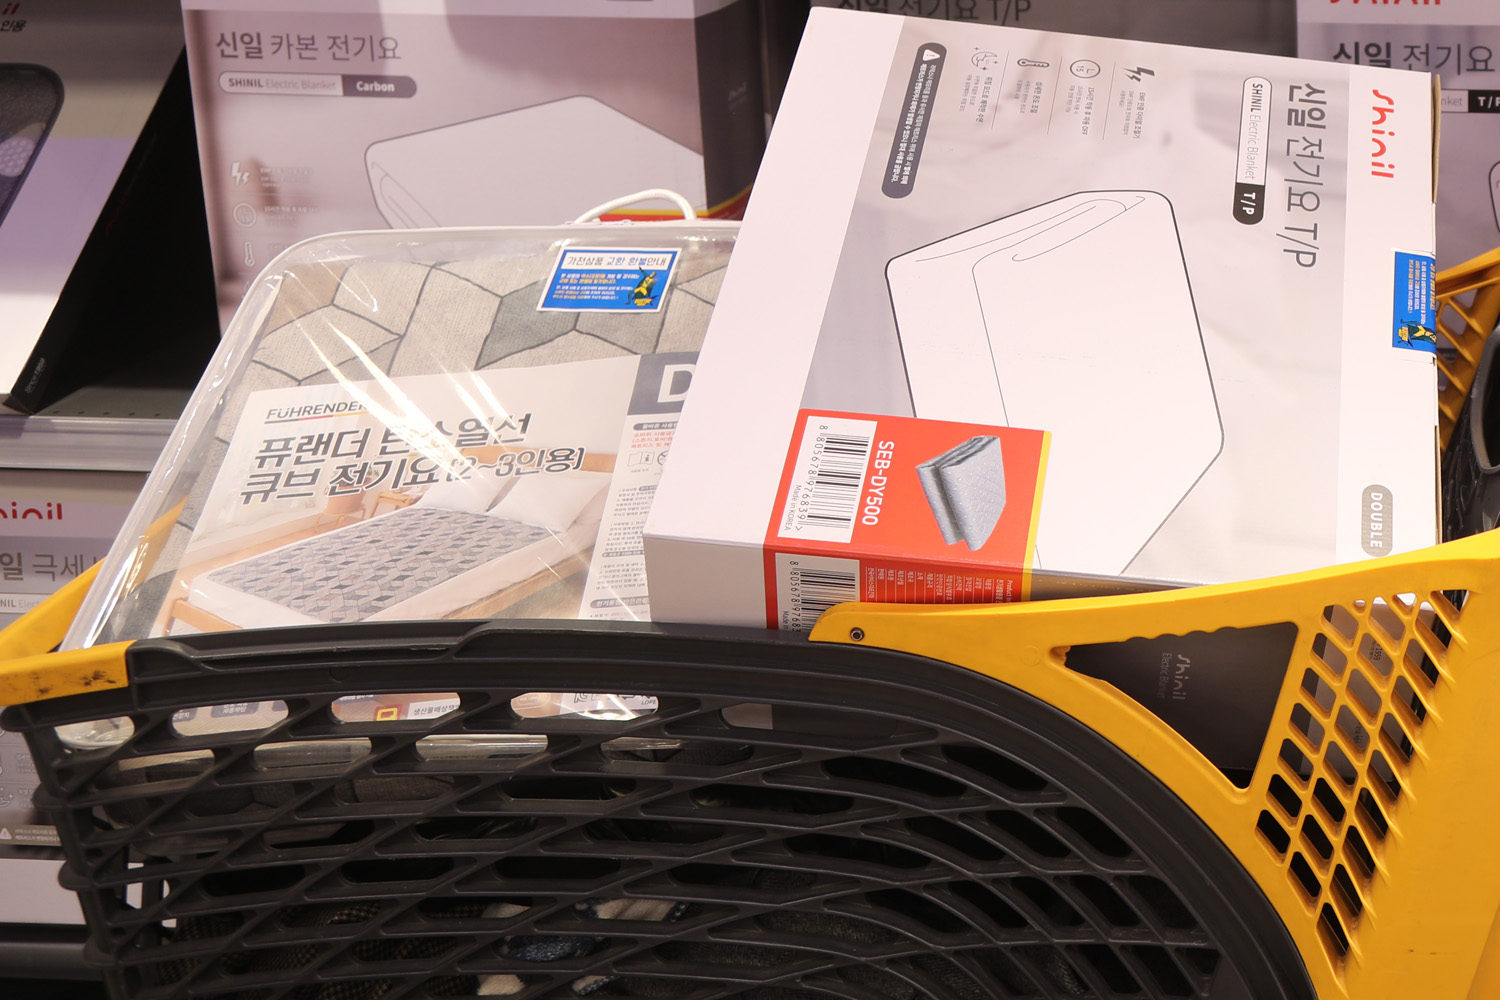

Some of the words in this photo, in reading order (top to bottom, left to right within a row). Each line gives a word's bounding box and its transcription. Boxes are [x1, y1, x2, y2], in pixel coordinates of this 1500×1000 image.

[215, 31, 264, 60] 신일
[270, 34, 319, 62] 카본
[326, 36, 401, 64] 전기요
[1402, 42, 1496, 77] 전기요
[228, 77, 264, 89] SHINIL
[265, 78, 300, 91] Electric
[301, 79, 336, 92] Blanket
[356, 80, 395, 93] Carbon
[1250, 83, 1263, 112] SHINIL
[1286, 83, 1327, 130] 신일
[1080, 125, 1088, 135] OFF
[1248, 114, 1261, 148] Electric
[1246, 147, 1259, 180] Blanket
[1284, 136, 1325, 212] 전기요
[1240, 192, 1256, 216] T/P
[568, 256, 604, 267] 가전상품
[1276, 222, 1320, 268] T/P
[255, 428, 371, 471] 퓨랜더
[807, 436, 825, 476] 805678
[239, 467, 321, 506] 큐브
[327, 458, 441, 499] 전기요
[792, 485, 802, 501] Made
[862, 440, 895, 526] SEB-DY500
[797, 481, 815, 521] 976839
[784, 509, 796, 531] KOREA
[1370, 491, 1384, 549] DOUBLE
[789, 570, 801, 603] 805678
